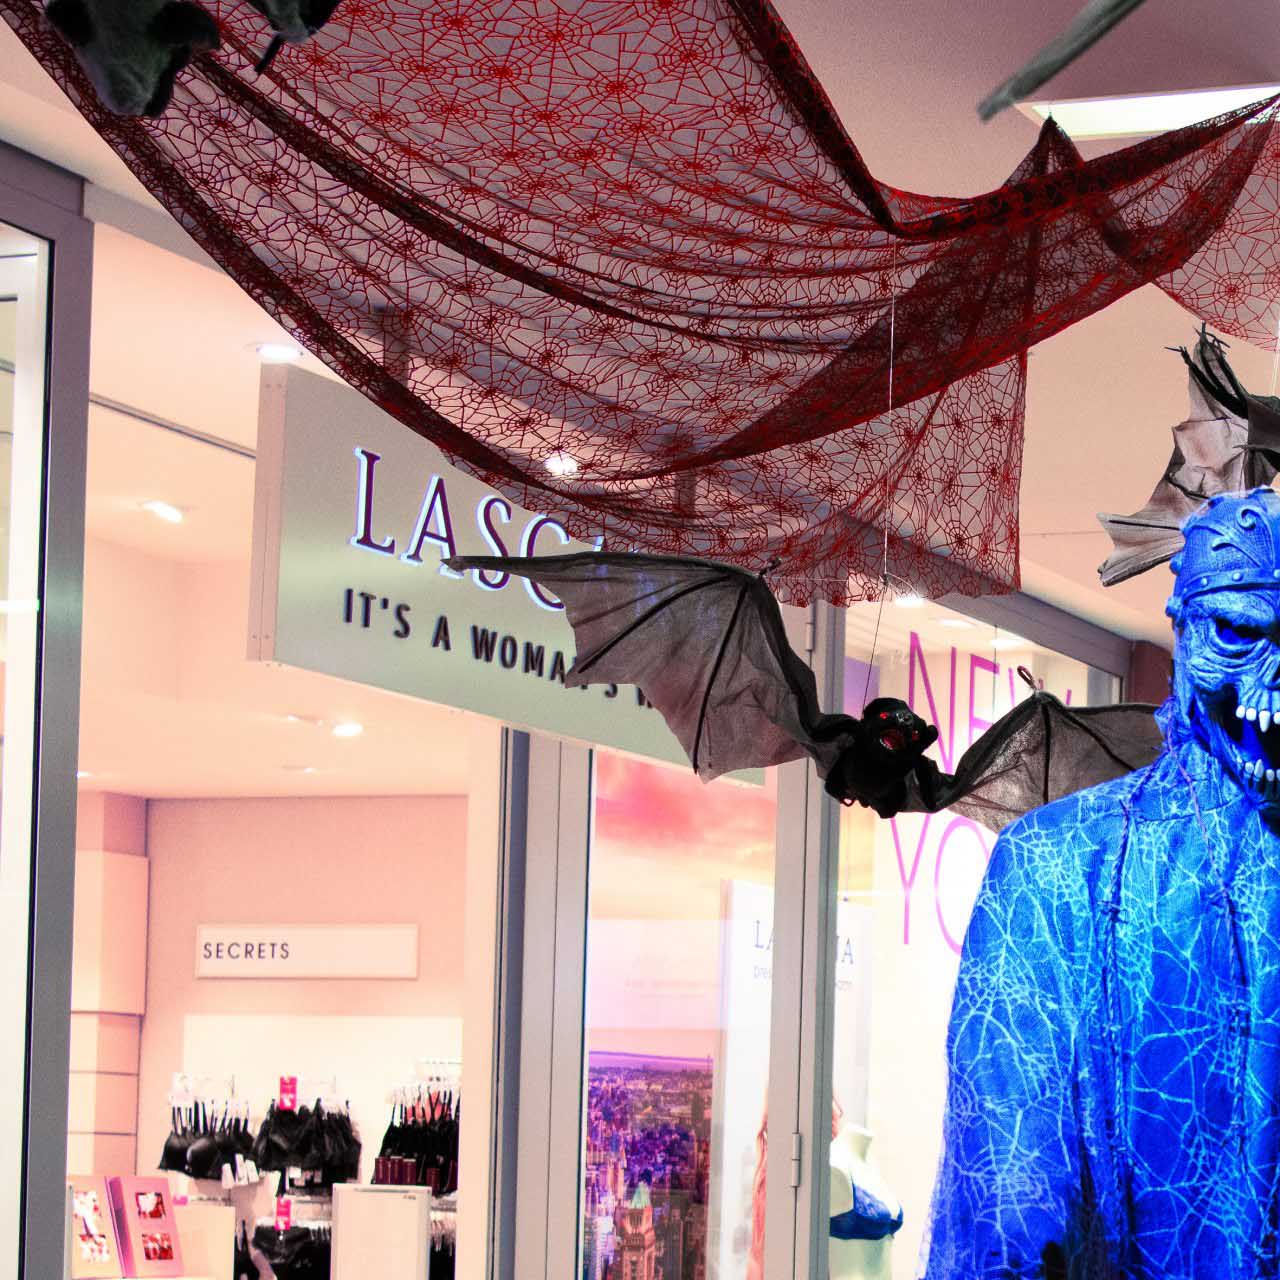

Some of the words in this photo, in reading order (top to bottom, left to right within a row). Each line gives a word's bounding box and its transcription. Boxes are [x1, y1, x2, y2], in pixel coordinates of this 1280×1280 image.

[343, 588, 412, 639] IT'S
[430, 615, 452, 651] A
[471, 624, 619, 699] WOMA
[203, 942, 289, 960] SECRETS
